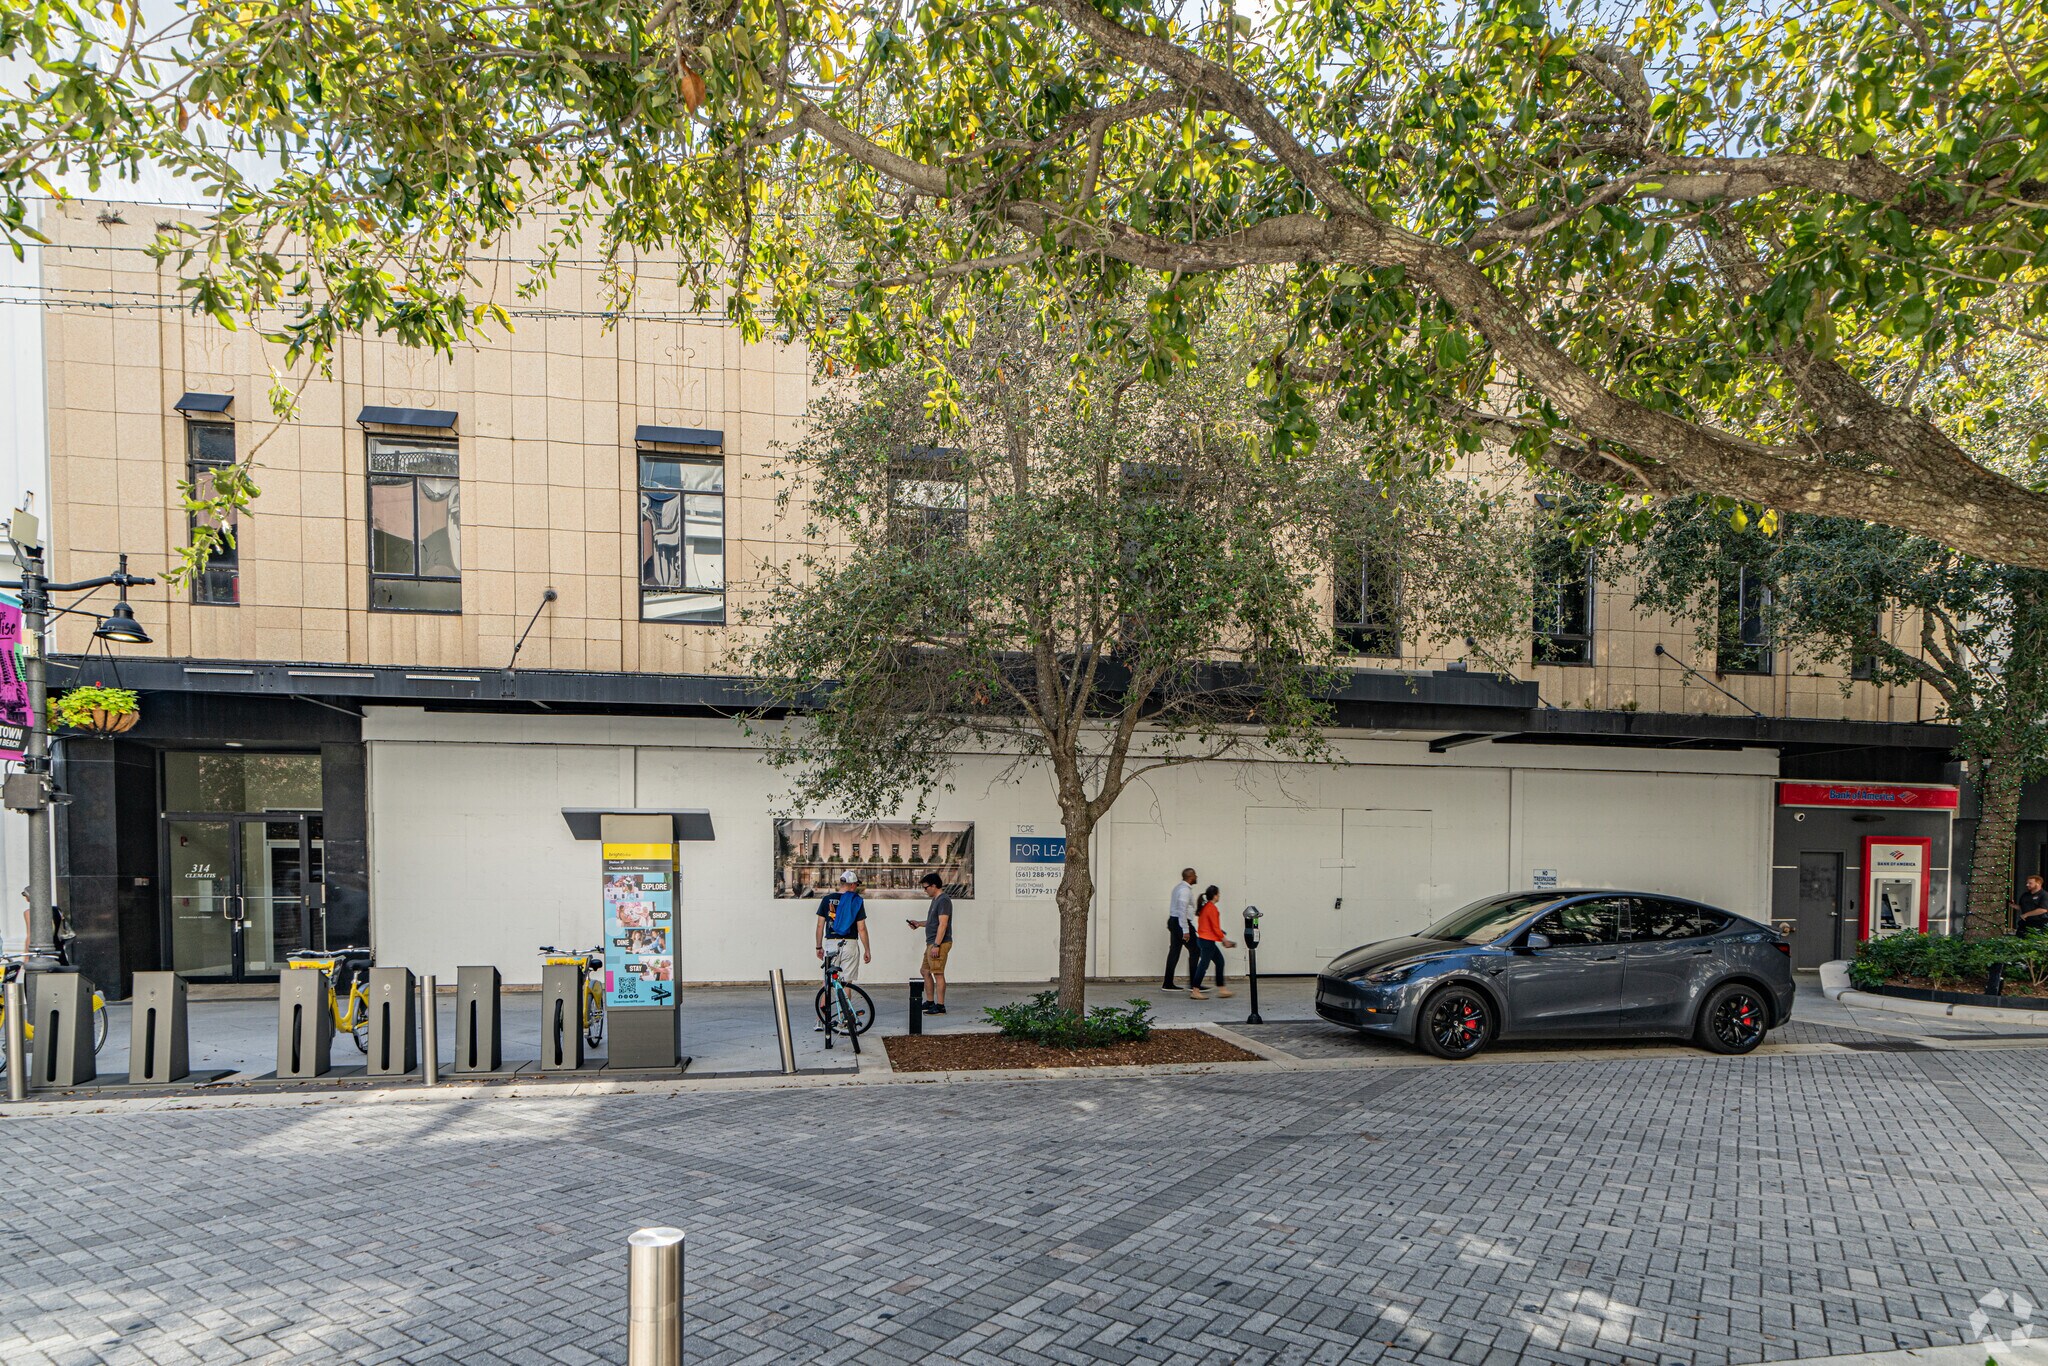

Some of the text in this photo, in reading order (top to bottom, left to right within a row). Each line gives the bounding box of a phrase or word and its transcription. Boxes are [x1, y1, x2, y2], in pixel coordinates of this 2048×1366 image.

[1829, 789, 1895, 801] Bank of America
[1015, 844, 1066, 857] FOR LEA
[191, 864, 211, 873] 314
[616, 938, 630, 946] DINE
[629, 965, 642, 973] STAY
